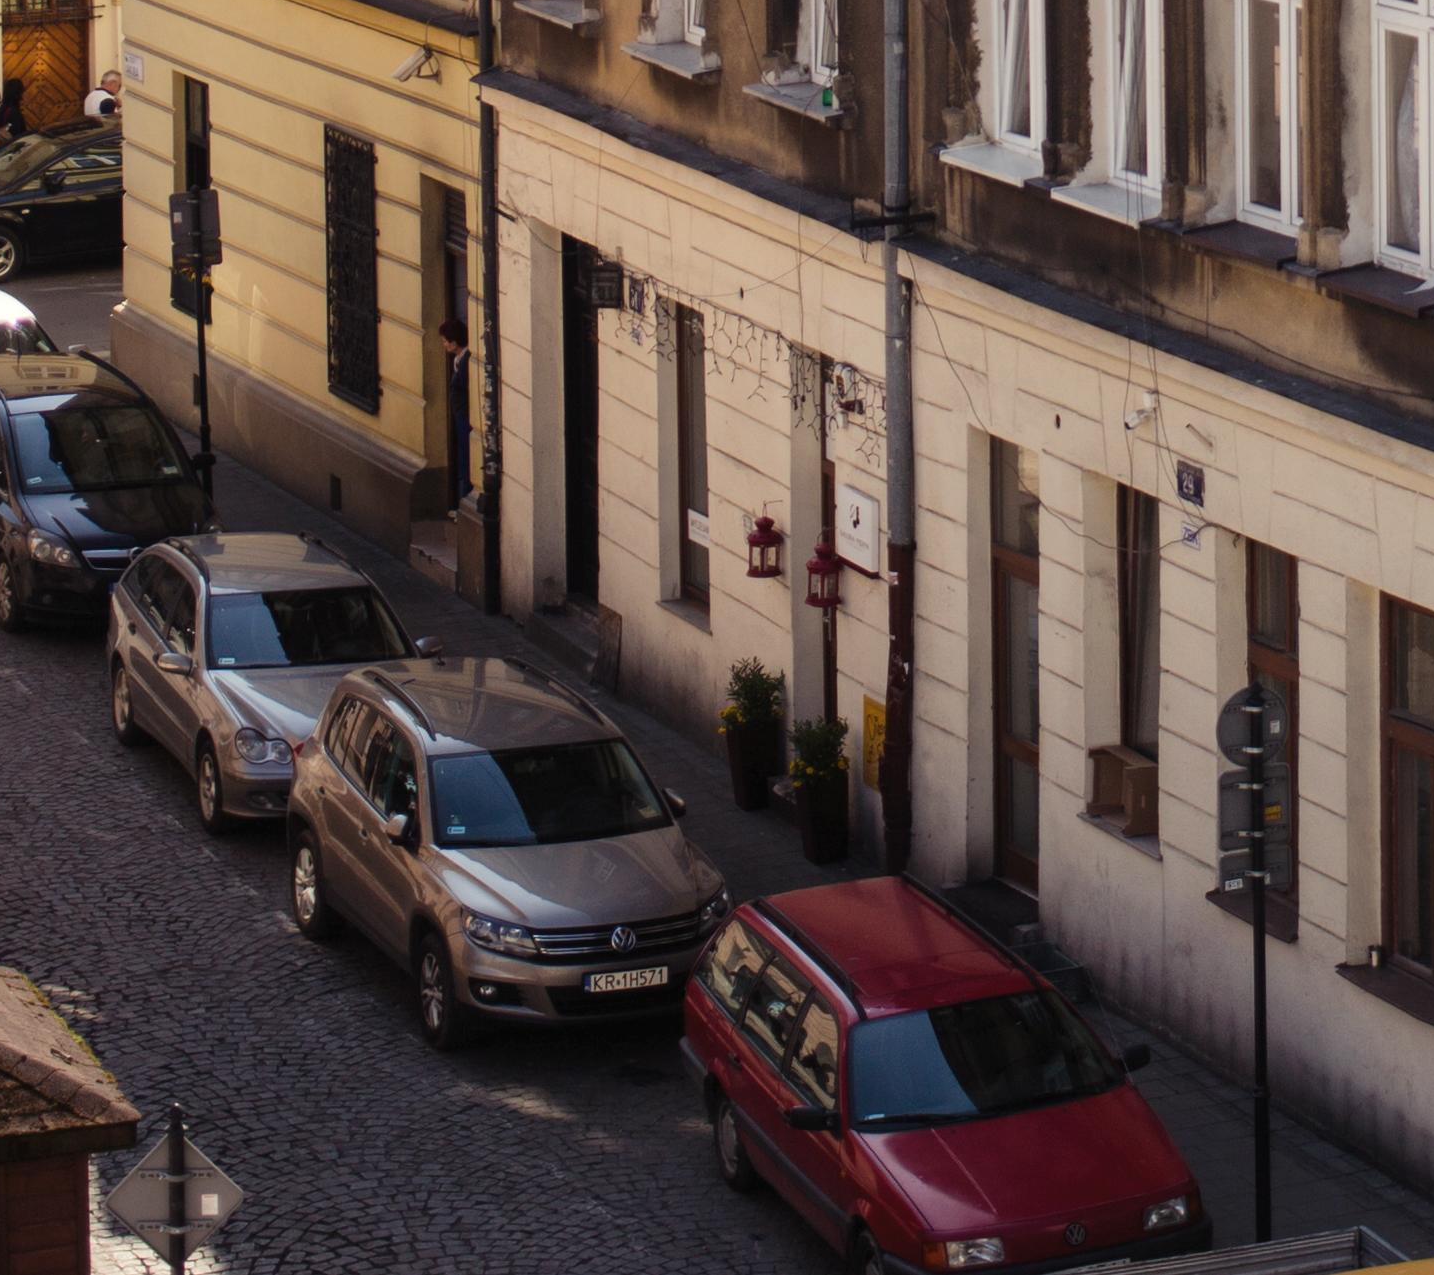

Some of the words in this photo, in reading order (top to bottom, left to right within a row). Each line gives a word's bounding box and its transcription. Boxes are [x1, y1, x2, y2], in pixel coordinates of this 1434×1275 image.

[1182, 472, 1195, 495] 29
[593, 974, 615, 991] KR
[622, 968, 664, 988] 1H571
